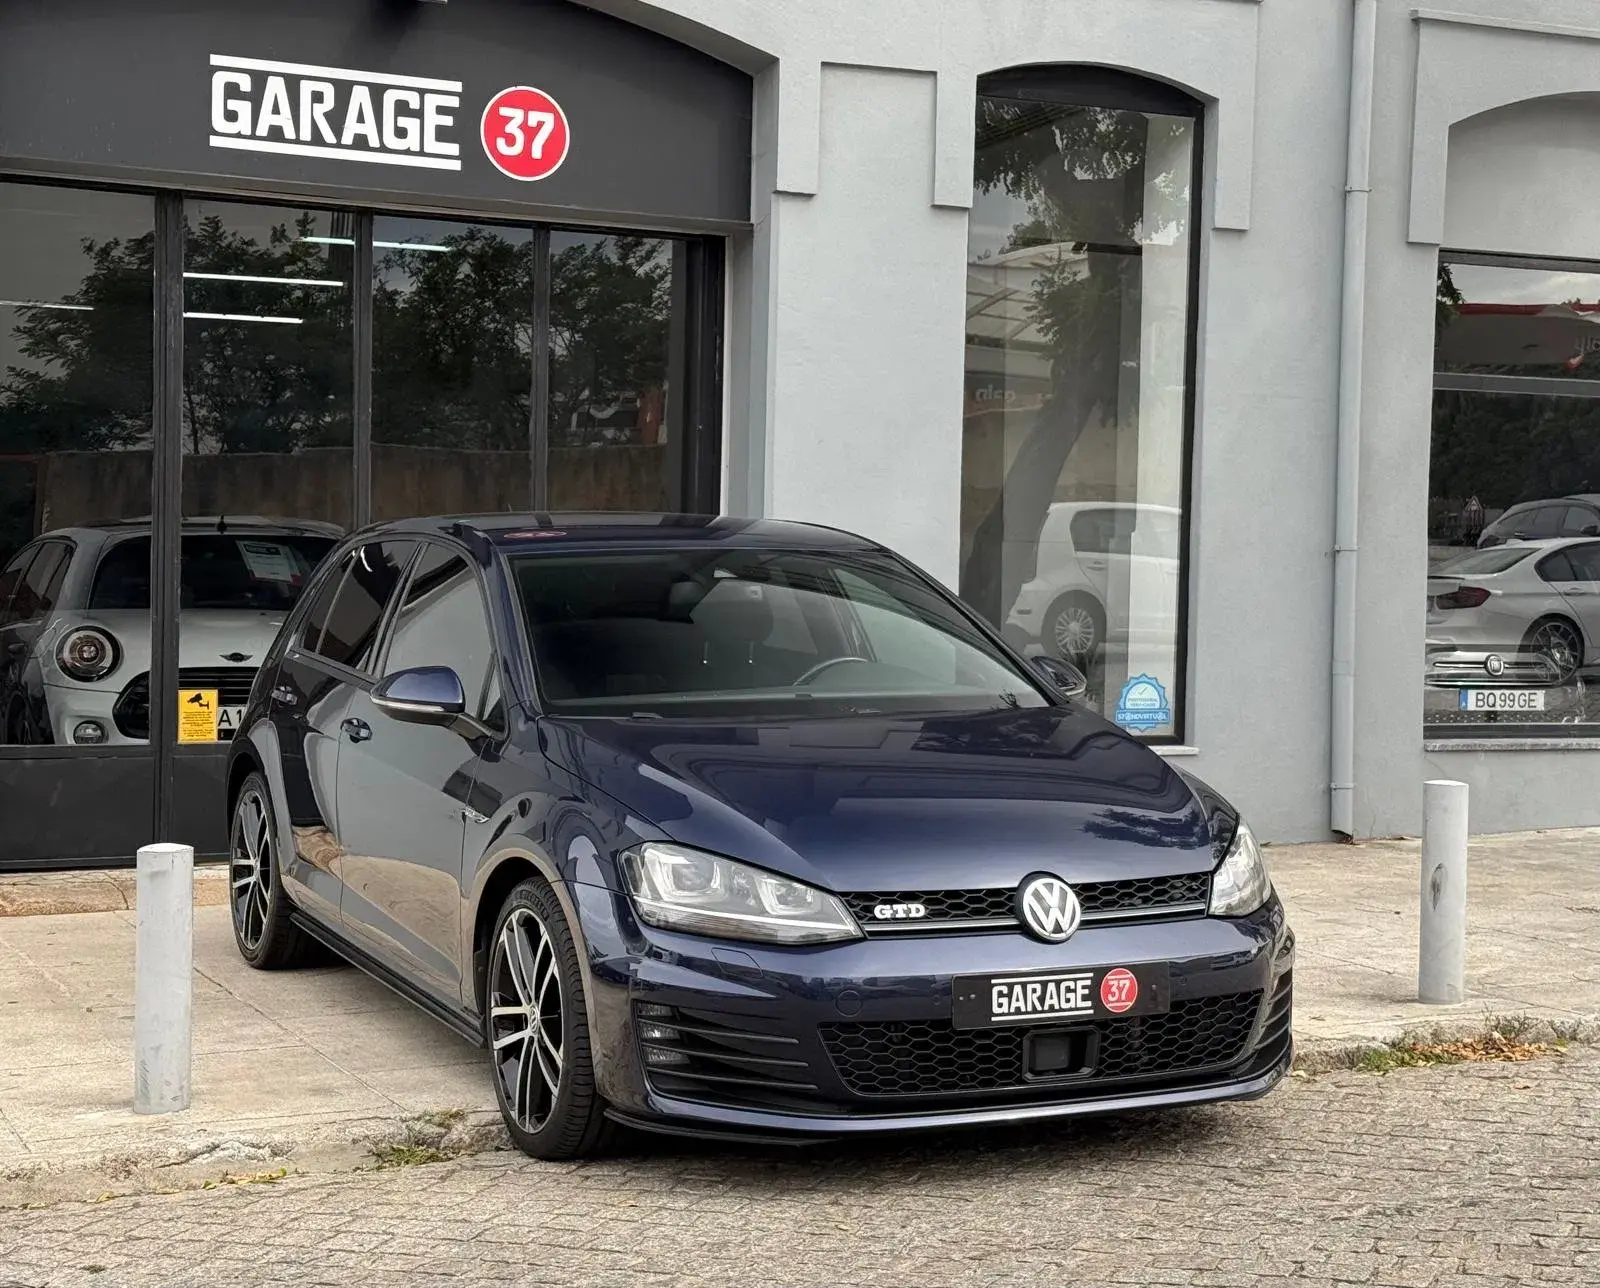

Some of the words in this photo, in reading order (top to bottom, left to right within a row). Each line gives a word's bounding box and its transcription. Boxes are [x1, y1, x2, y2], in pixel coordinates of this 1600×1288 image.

[211, 70, 460, 156] GARAGE
[496, 107, 555, 159] 37
[873, 904, 926, 919] GTD
[992, 979, 1092, 1014] GARAGE
[1107, 979, 1131, 1001] 37
